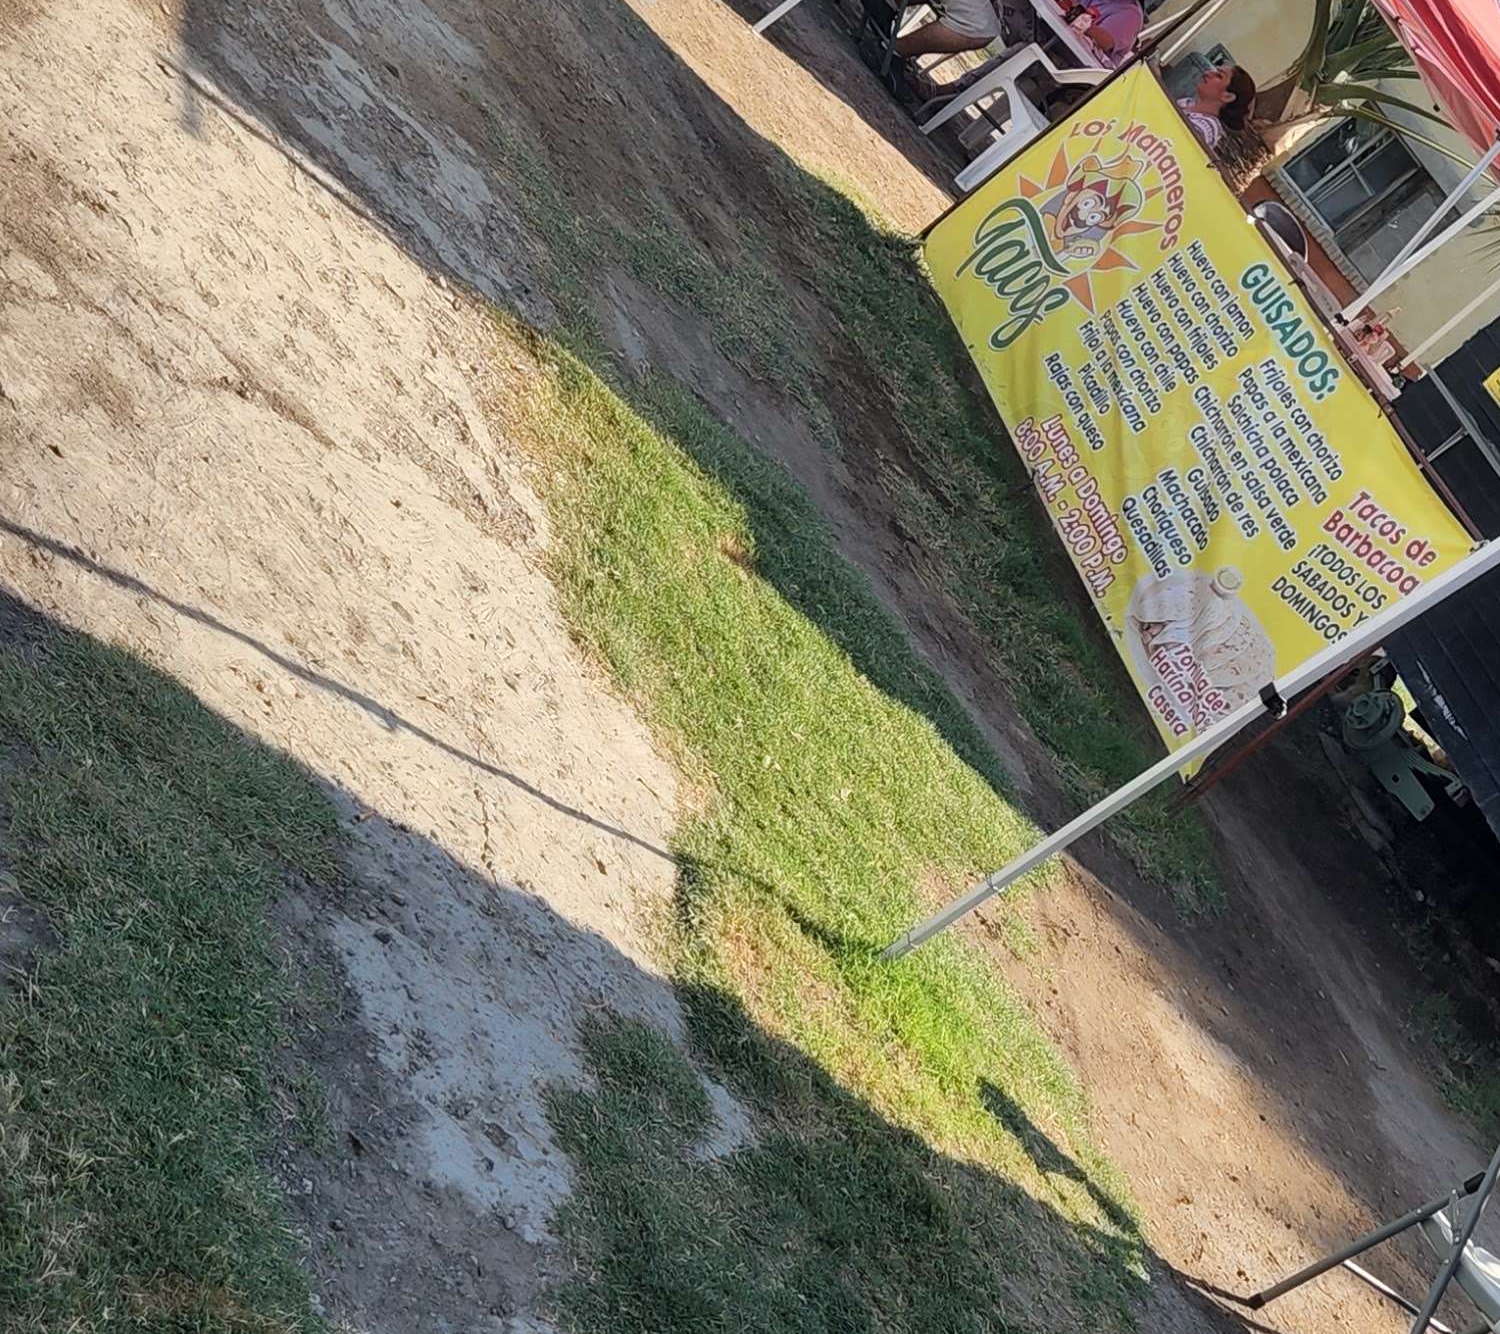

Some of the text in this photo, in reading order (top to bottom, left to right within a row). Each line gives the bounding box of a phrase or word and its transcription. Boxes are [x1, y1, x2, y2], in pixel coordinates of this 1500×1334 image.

[1117, 120, 1184, 251] Mañaneros
[955, 199, 1071, 349] Tacos
[1148, 267, 1222, 372] Huevo con frijoles
[1165, 251, 1242, 359] Huevo con chorizo
[1184, 239, 1256, 341] Huevo con jamon
[1075, 320, 1148, 433] Frijol a la mexicana
[1094, 309, 1165, 415] Papas con chorizo
[1113, 298, 1178, 393] Huevo con chile
[1130, 281, 1200, 386] Huevo con papas
[1236, 259, 1346, 402] GUISADOS:
[1041, 351, 1107, 452] Rajas con queso
[1075, 362, 1115, 415] Picadillo
[1234, 366, 1331, 505] Papas a la mexicana
[1256, 357, 1346, 482] Frijoles con chorizo
[1039, 412, 1135, 568] Lunes a Domingo
[1185, 465, 1227, 523] Guisado
[1187, 423, 1260, 539] Chicharrón de res
[1191, 383, 1300, 552] Chicharrón en salsa verde
[1224, 393, 1302, 508] Salchicha polaca
[1010, 416, 1049, 464] 8:00
[1030, 455, 1069, 504] A.M.
[1056, 505, 1099, 559] 2:00
[1078, 550, 1120, 600] P.M.
[1117, 495, 1176, 579] Quesadillas
[1138, 484, 1198, 567] Choriqueso
[1157, 467, 1216, 551] Machacado
[1321, 509, 1421, 597] Barbacoa
[1346, 490, 1440, 570] Tacos de
[1290, 558, 1370, 630] SABADOS Y
[1352, 578, 1389, 611] LOS
[1145, 683, 1190, 738] Casera
[1148, 649, 1195, 704] Harina
[1203, 688, 1226, 713] de
